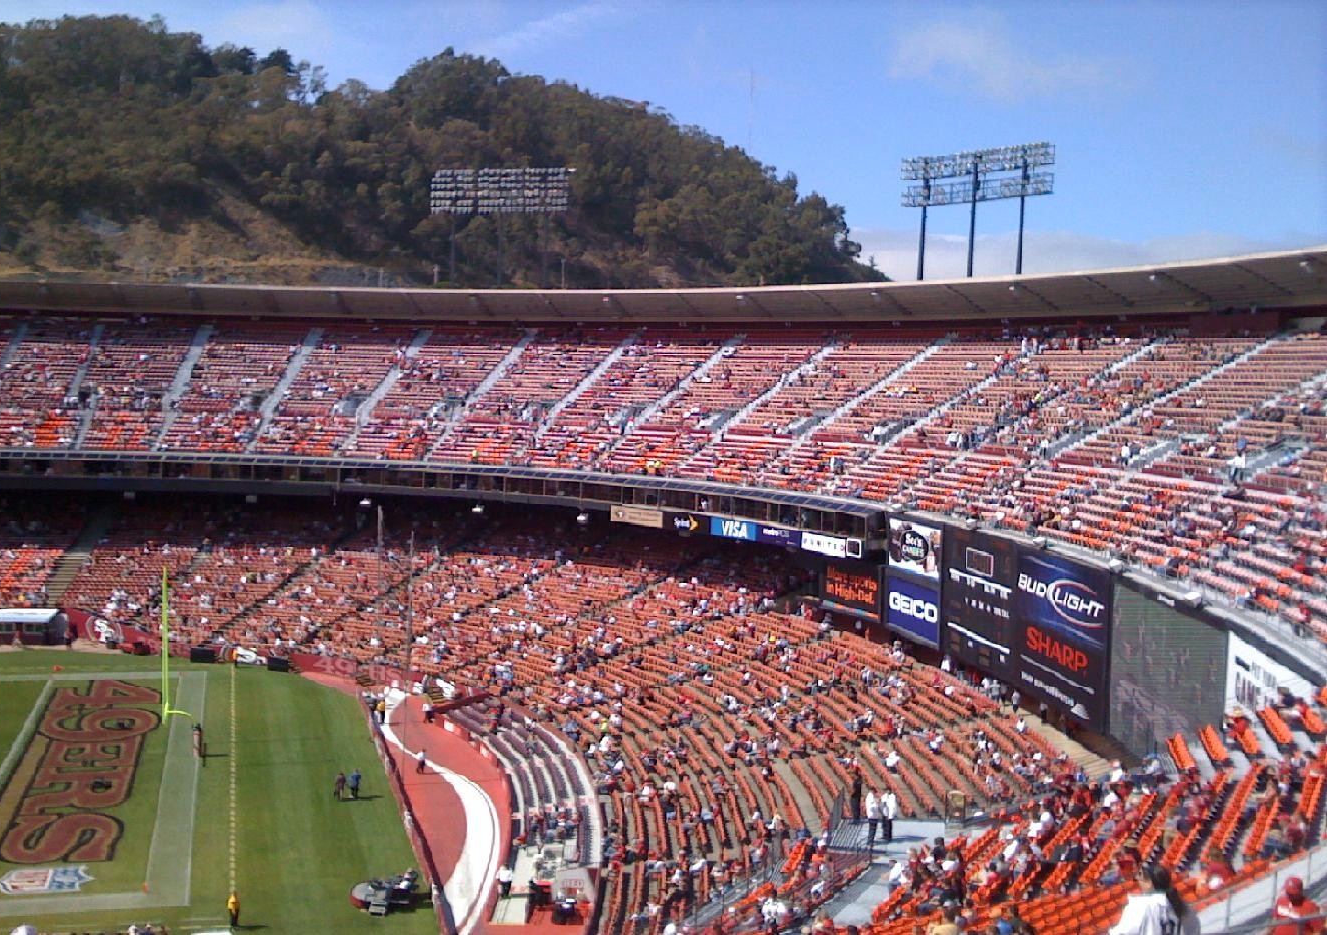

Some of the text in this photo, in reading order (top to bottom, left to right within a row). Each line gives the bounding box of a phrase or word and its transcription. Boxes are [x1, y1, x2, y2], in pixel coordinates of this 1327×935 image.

[722, 520, 747, 539] VISA
[889, 591, 938, 623] GEICO
[1018, 573, 1046, 598] BUD
[1055, 587, 1105, 617] LIGHT
[1026, 625, 1089, 672] SHARP
